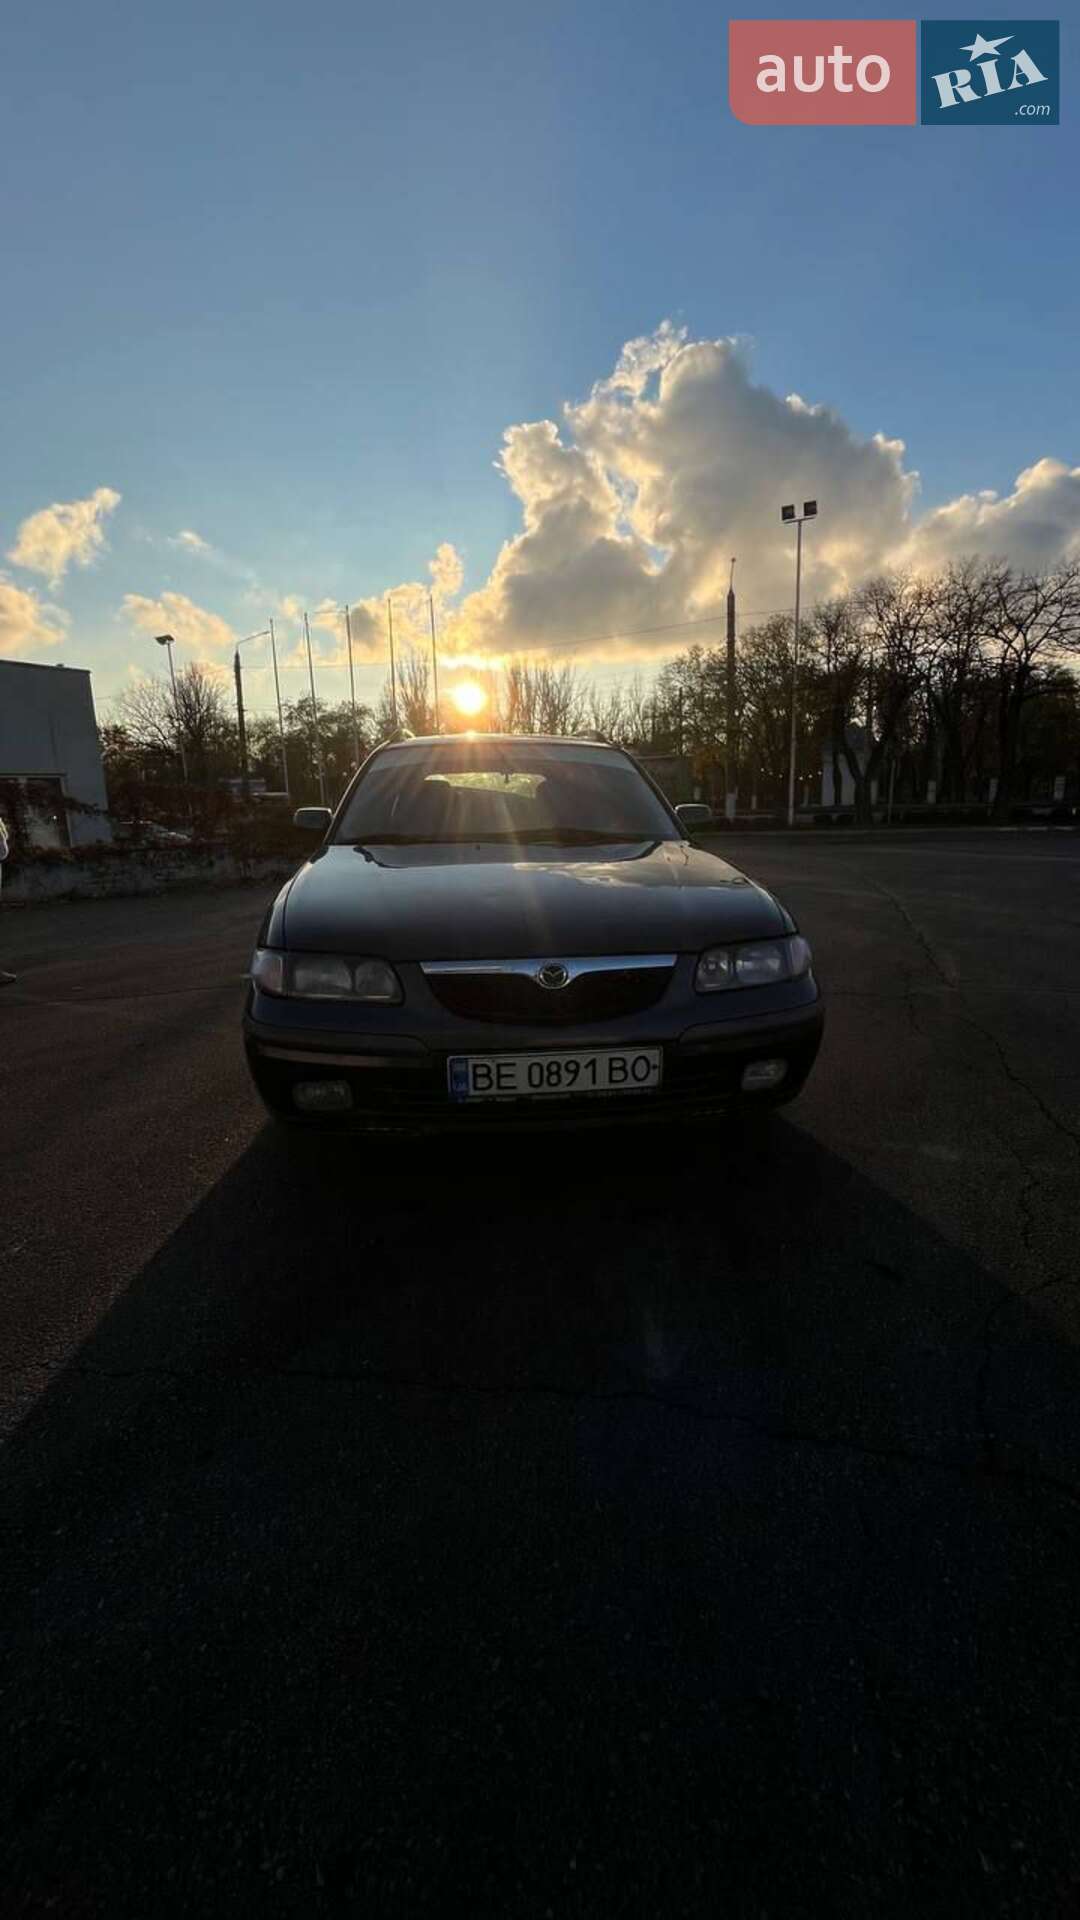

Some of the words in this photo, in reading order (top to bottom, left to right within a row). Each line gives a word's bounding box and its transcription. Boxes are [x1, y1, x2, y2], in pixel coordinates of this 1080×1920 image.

[472, 1063, 517, 1091] BE
[528, 1058, 597, 1088] 0891
[608, 1056, 651, 1084] BO
